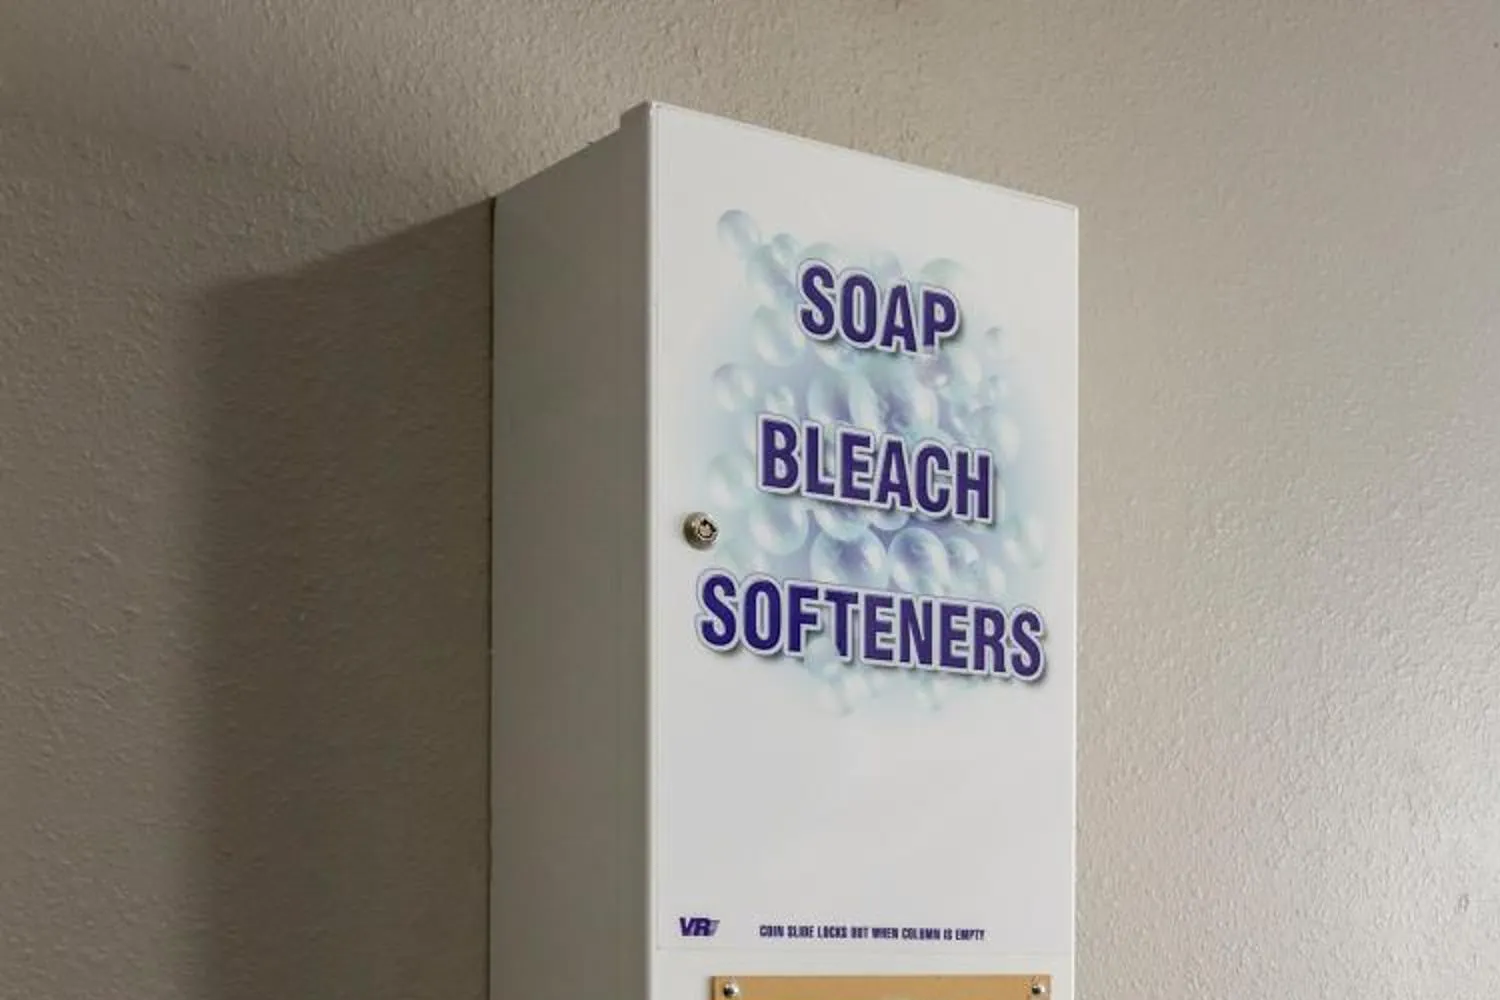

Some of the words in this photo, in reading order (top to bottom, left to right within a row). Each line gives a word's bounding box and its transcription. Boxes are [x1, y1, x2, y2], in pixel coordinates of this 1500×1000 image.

[800, 264, 960, 353] SOAP
[761, 418, 991, 521] BLEACH
[700, 574, 1043, 678] SOFTENERS
[759, 925, 784, 937] COIN
[787, 925, 814, 939] SLIDE
[817, 925, 847, 939] LOCKS
[871, 927, 899, 939] WHEN
[901, 927, 940, 940] COLUMN
[955, 928, 985, 941] EMPTY
